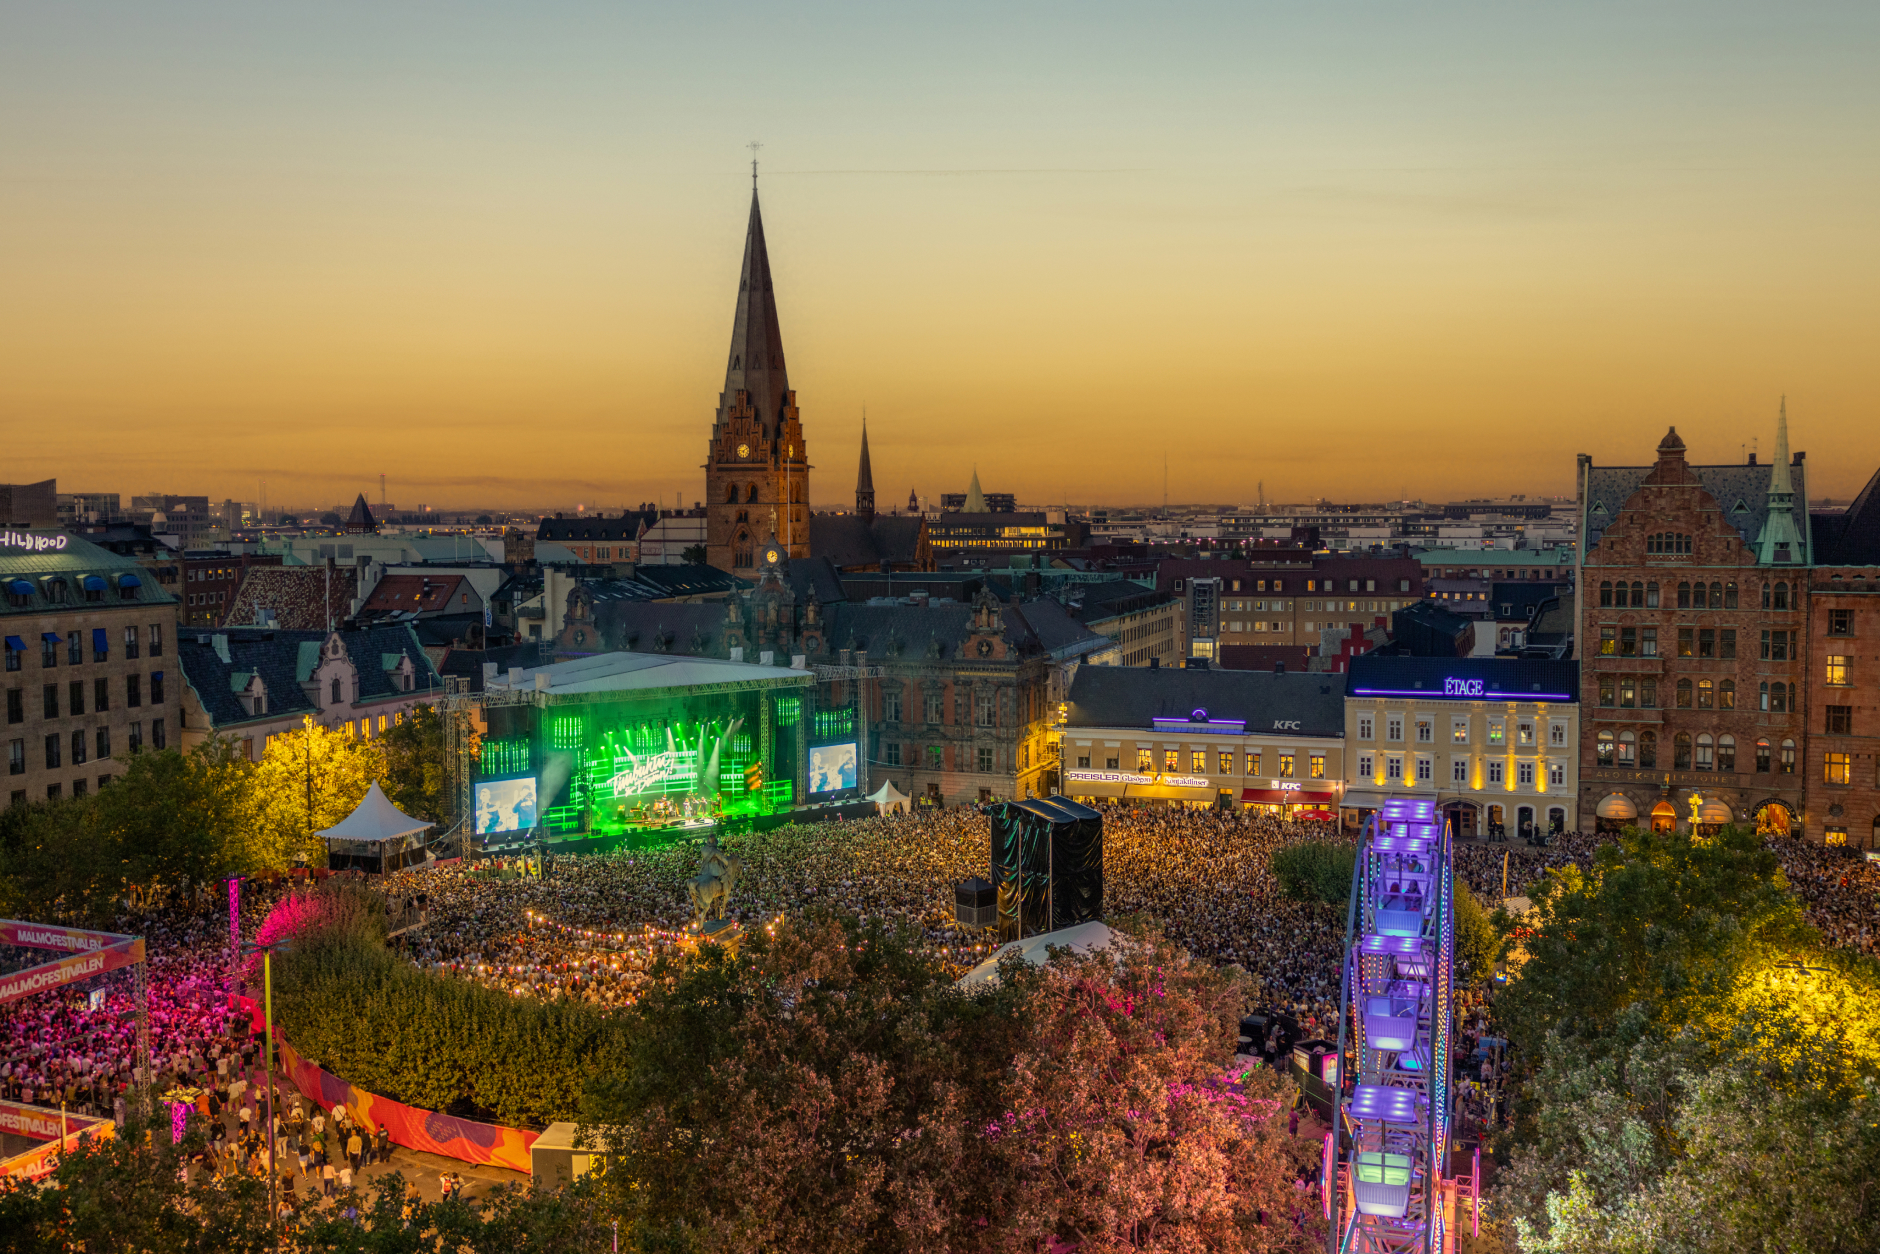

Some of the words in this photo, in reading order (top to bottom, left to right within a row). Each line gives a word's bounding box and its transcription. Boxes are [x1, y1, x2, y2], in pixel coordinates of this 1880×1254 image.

[1445, 677, 1484, 696] ÉTAGE
[1273, 720, 1301, 730] KFC
[1069, 772, 1120, 781] PREISLER
[1164, 776, 1208, 786] Kontaktlinser
[1281, 782, 1301, 790] KFC
[17, 930, 102, 950] MALMÖFESTIVALEN
[0, 1113, 62, 1138] FESTIVALEN
